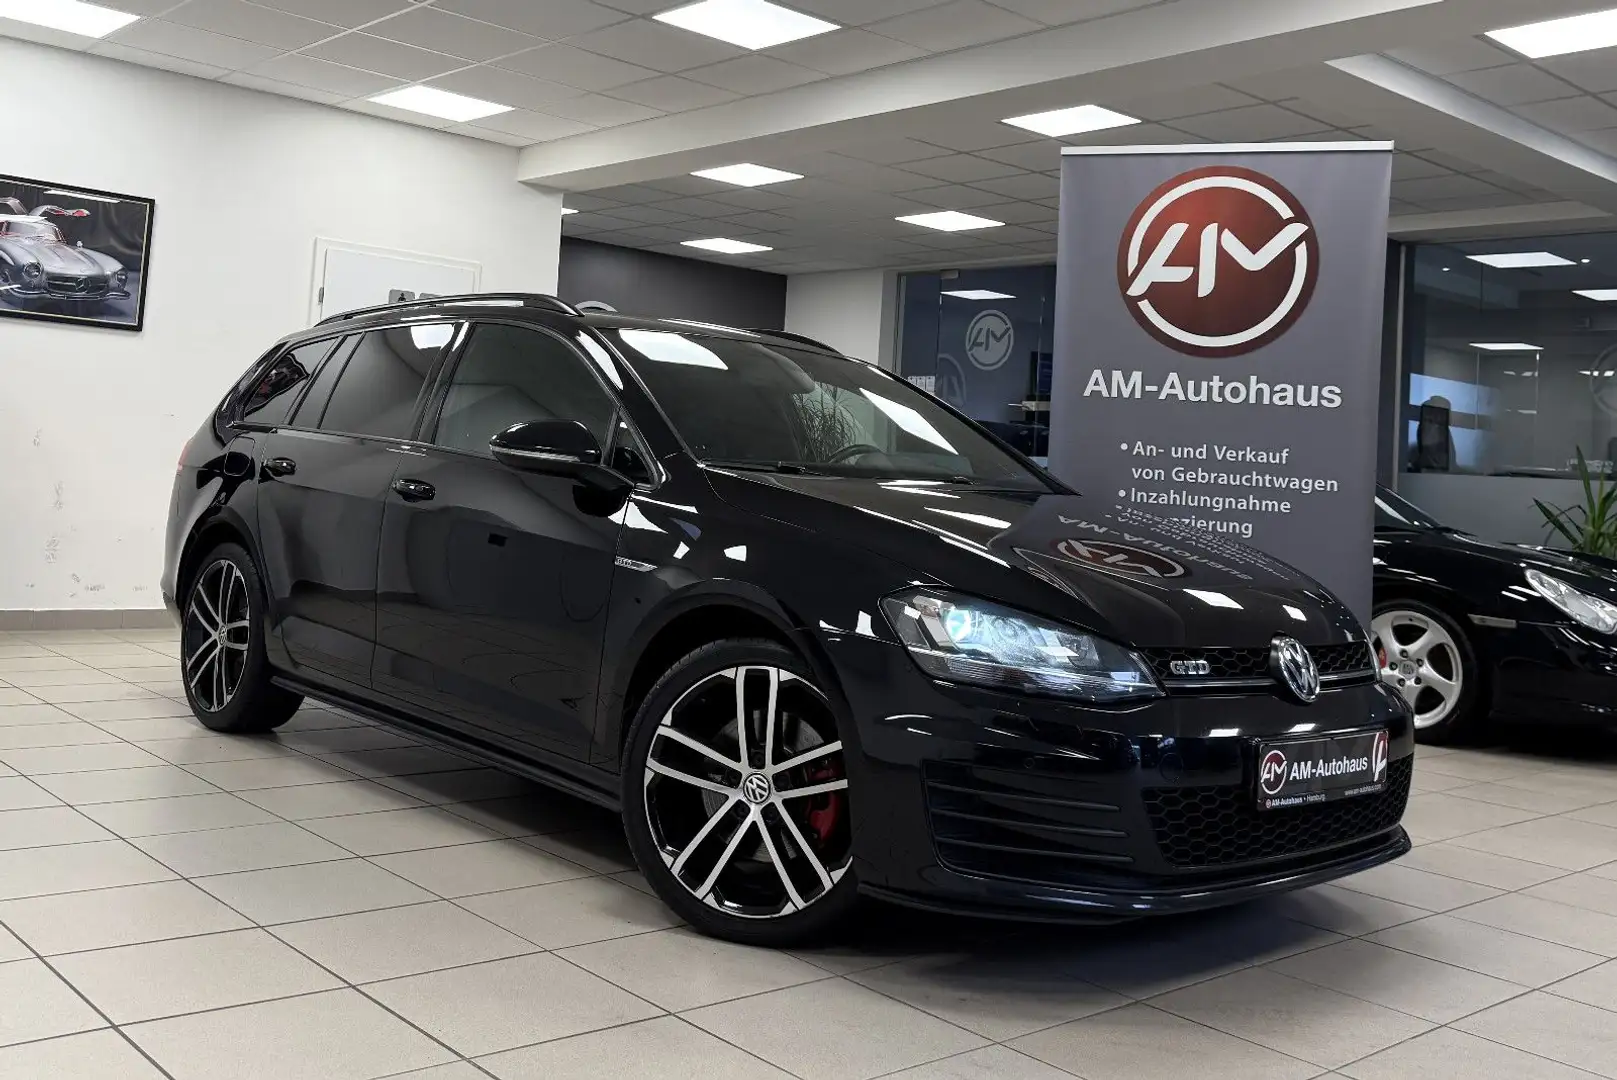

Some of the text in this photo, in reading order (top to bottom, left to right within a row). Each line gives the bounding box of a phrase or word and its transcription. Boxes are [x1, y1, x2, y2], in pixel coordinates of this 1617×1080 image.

[1083, 369, 1343, 409] AM-Autohaus
[1132, 441, 1290, 465] An- und Verkauf
[1132, 466, 1339, 494] von Gebrauchtwagen
[1130, 487, 1291, 513] Inzahlungnahme
[1169, 660, 1211, 675] GTD
[1289, 755, 1368, 781] AM-Autohaus
